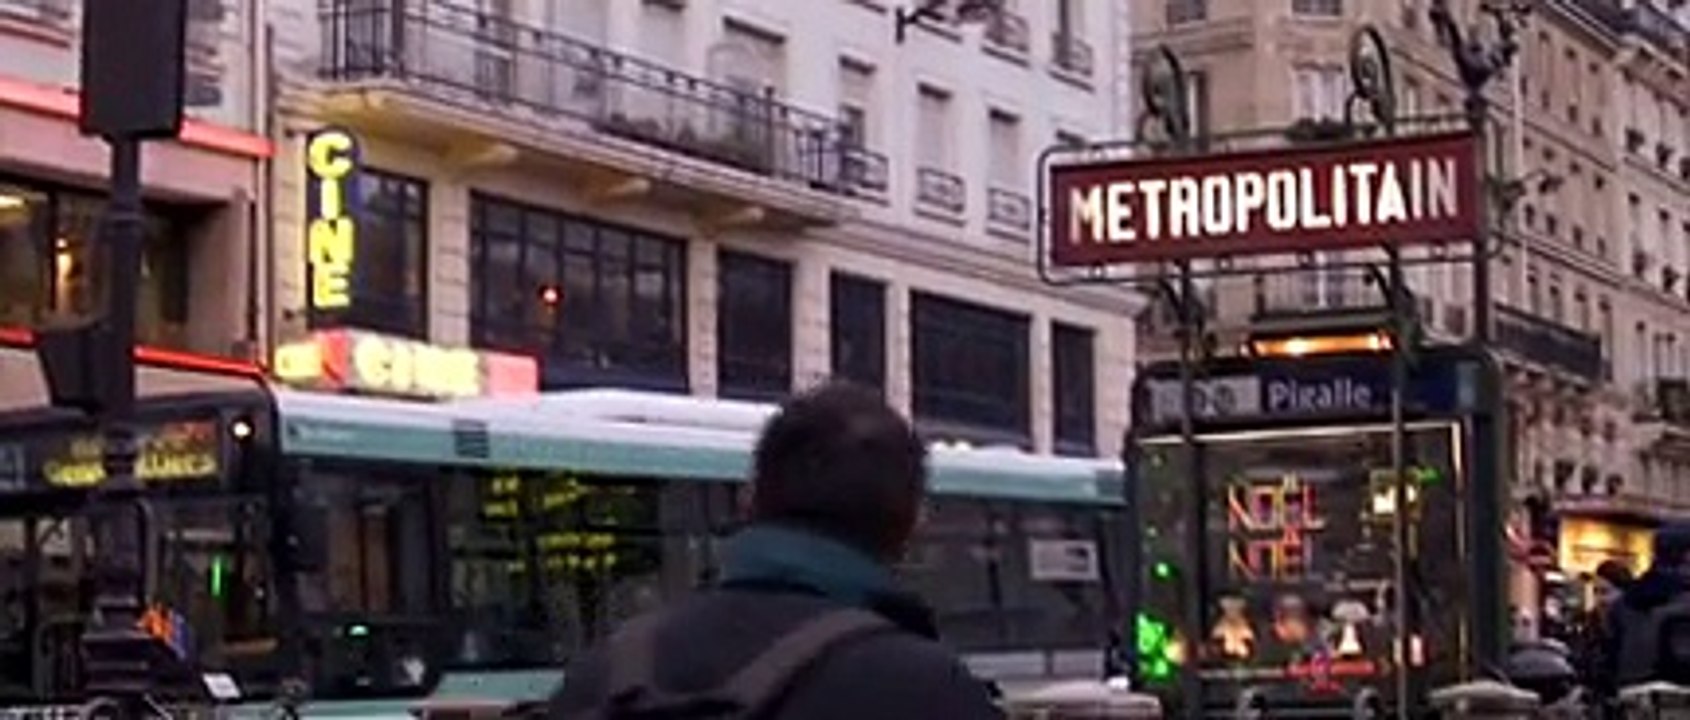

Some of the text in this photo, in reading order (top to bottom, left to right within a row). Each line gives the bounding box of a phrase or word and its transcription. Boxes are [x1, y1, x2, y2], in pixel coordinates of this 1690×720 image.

[309, 132, 353, 306] CINE
[1069, 157, 1459, 244] METROPOLITAIN
[1268, 377, 1372, 412] Pigalle
